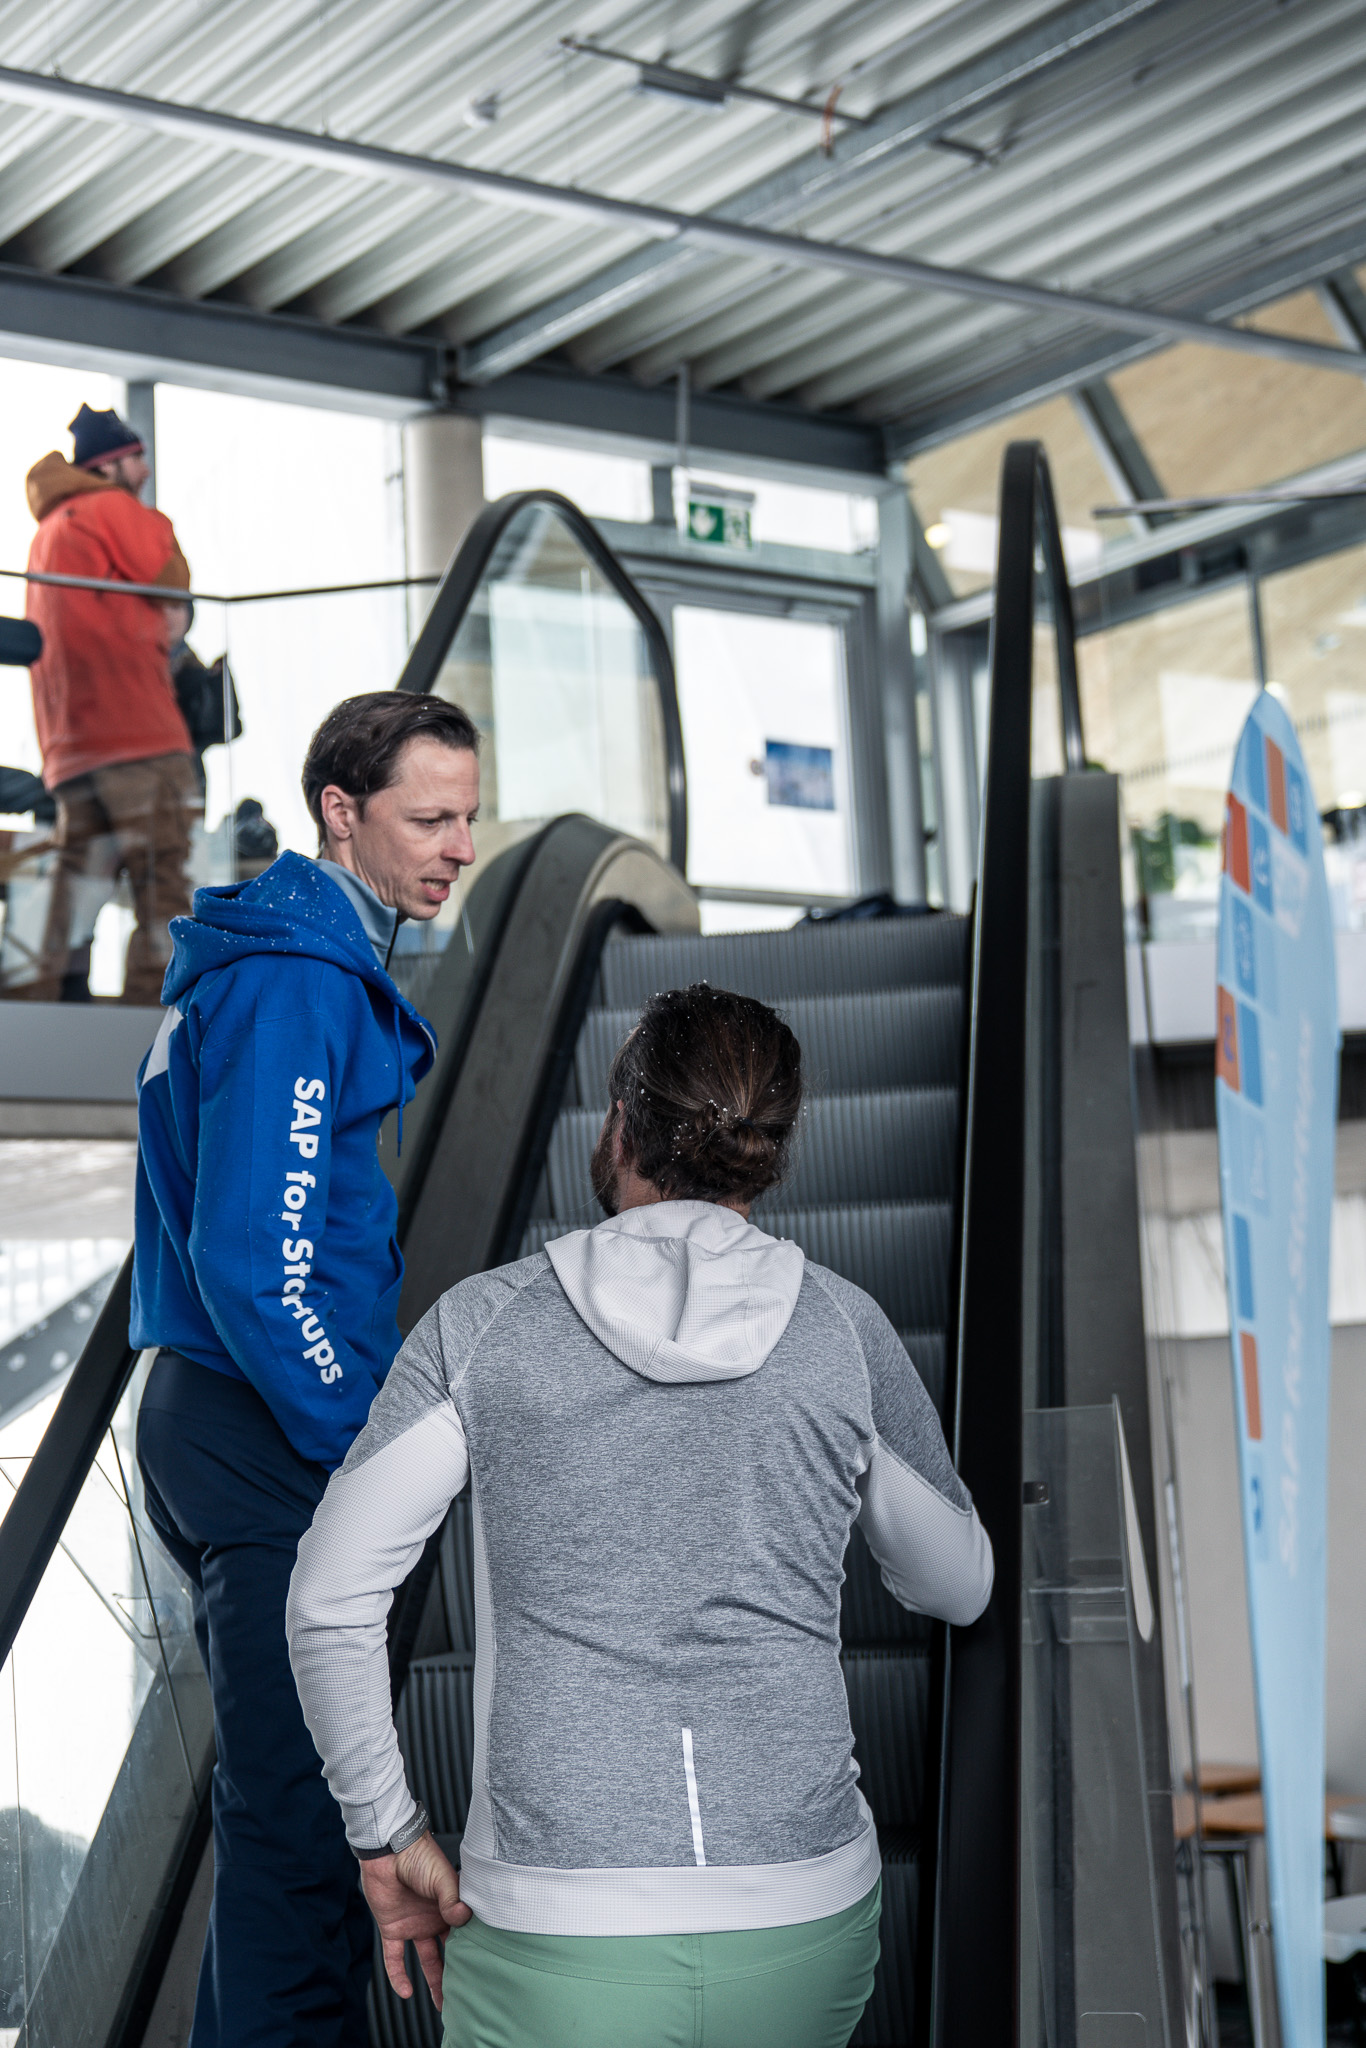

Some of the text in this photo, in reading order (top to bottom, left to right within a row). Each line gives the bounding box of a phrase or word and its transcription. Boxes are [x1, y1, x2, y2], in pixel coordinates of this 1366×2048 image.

[281, 1076, 343, 1384] SAP for Startups
